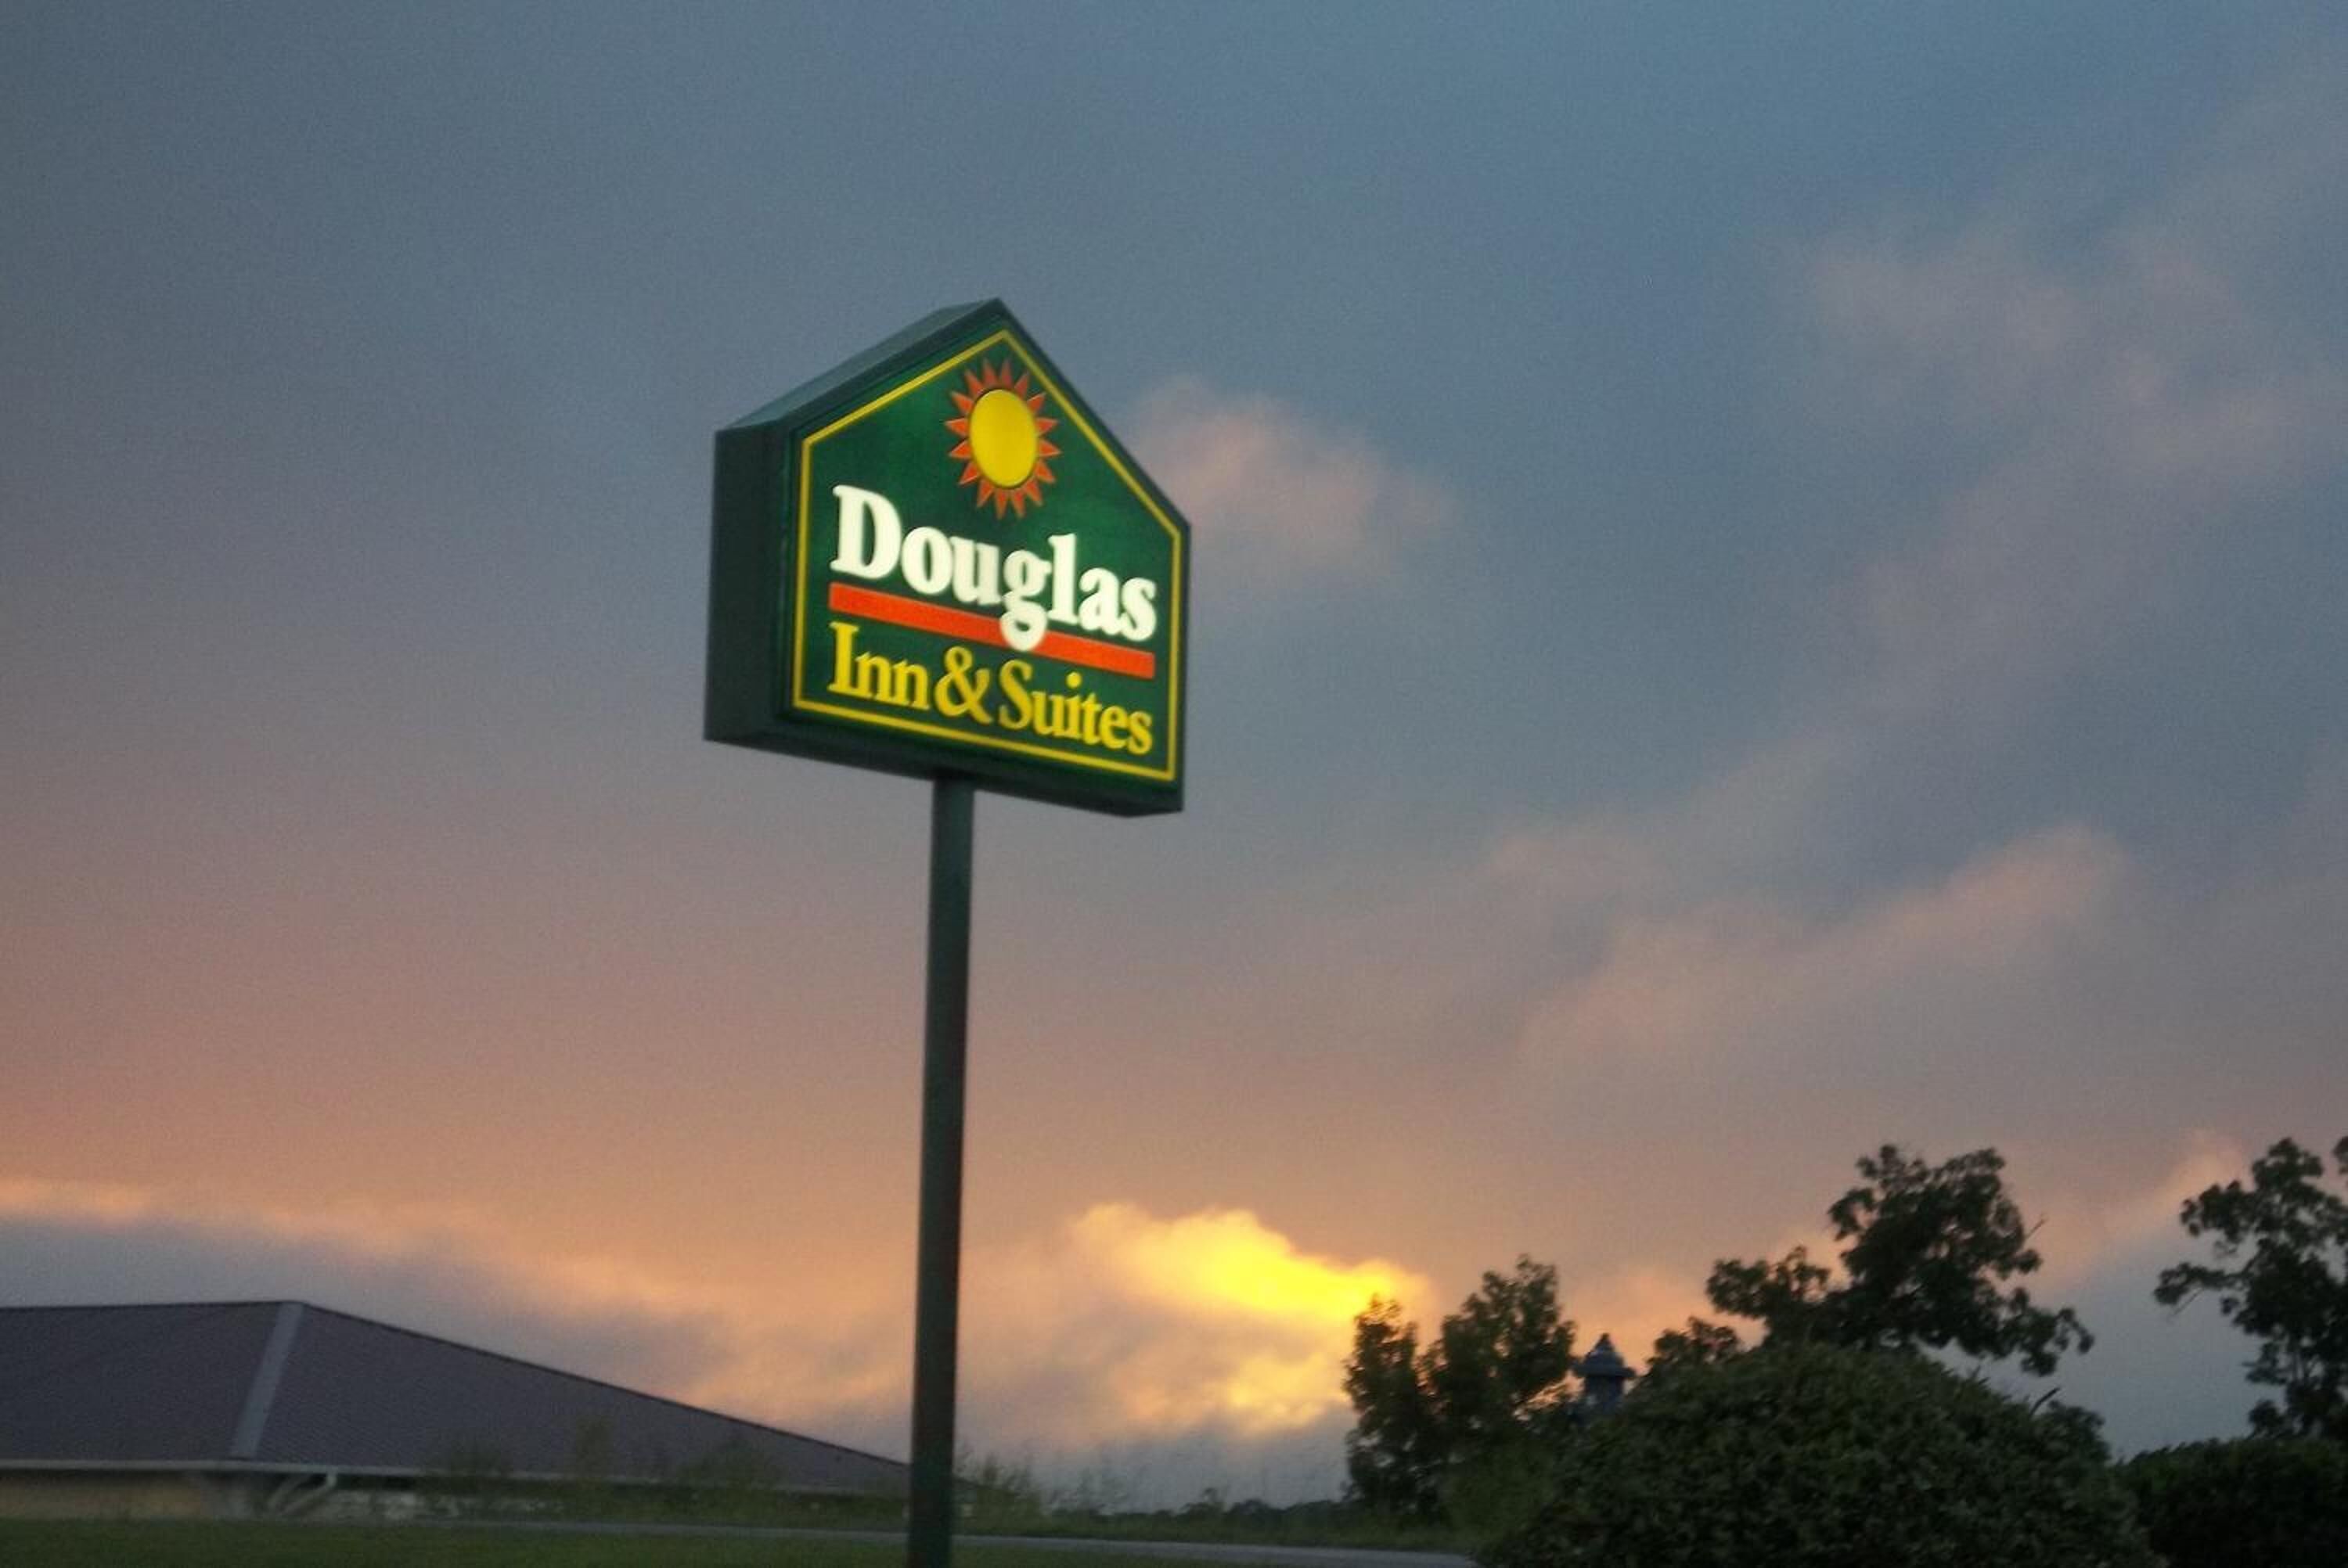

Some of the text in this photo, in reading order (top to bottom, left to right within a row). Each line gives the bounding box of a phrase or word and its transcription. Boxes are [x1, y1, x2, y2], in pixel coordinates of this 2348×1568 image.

[830, 484, 1157, 651] Douglas
[828, 621, 930, 710] Inn
[998, 659, 1153, 755] Suites
